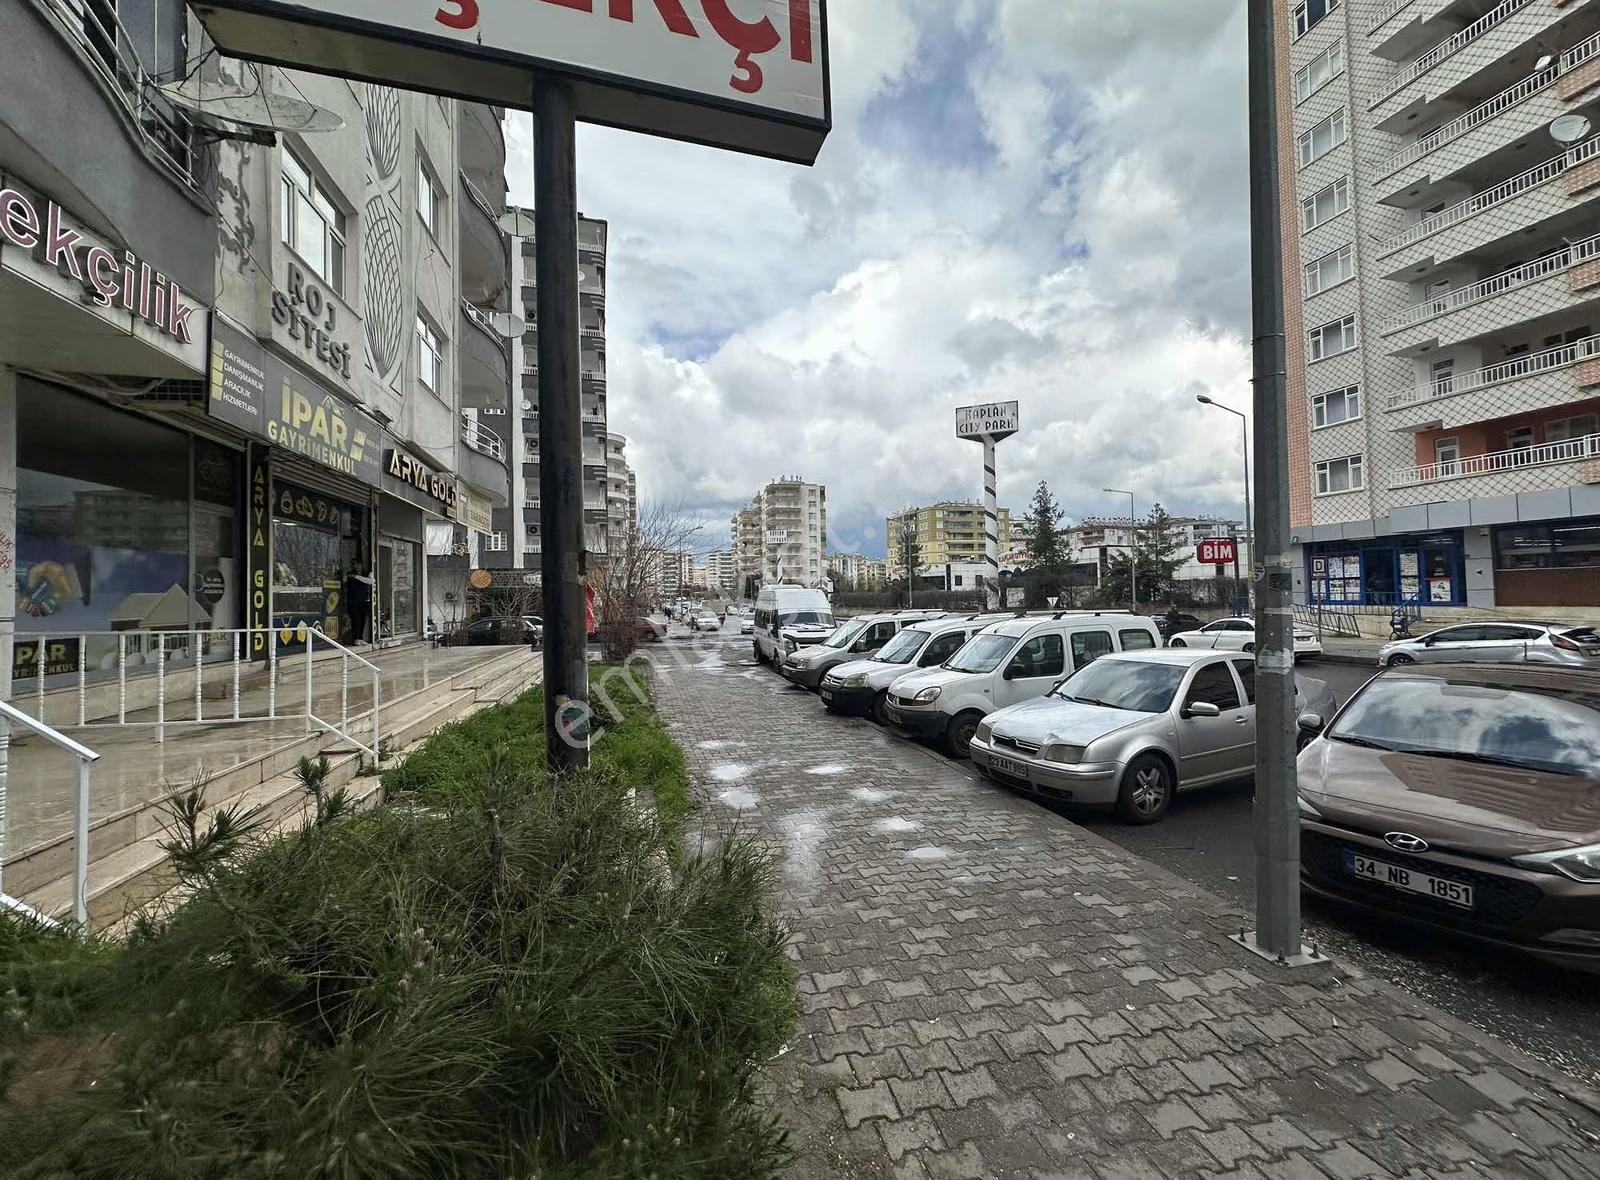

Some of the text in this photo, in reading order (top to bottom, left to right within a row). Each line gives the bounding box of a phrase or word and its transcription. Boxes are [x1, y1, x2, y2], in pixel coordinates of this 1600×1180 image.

[288, 262, 336, 330] ROJ
[272, 289, 351, 379] SİTESİ
[282, 376, 348, 454] İPAR
[959, 418, 1014, 433] CITY PARK
[965, 406, 1007, 420] KAPLAN
[389, 449, 428, 492] ARYA
[1203, 542, 1233, 560] BİM
[253, 569, 265, 651] GOLD
[1356, 858, 1472, 904] 34 NB 1851
